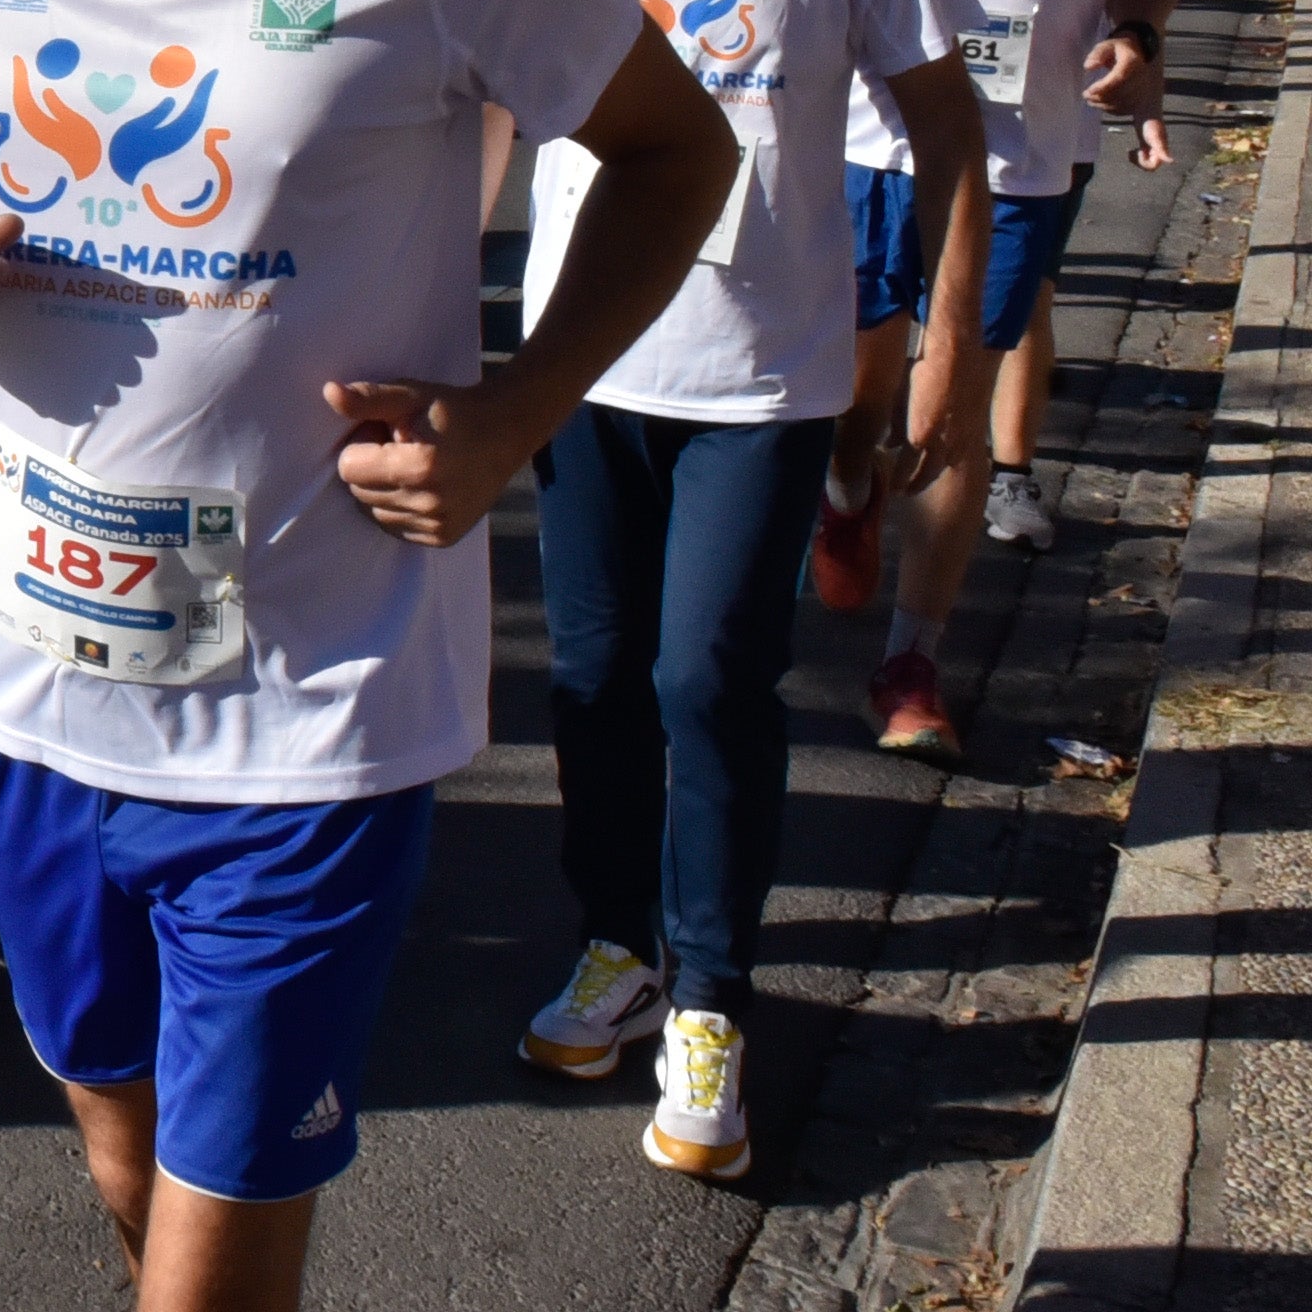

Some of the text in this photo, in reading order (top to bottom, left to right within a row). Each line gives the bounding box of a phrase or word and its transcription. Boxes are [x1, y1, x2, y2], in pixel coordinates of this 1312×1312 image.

[962, 39, 1000, 61] 61
[77, 196, 138, 227] 10ª
[62, 278, 147, 304] ASPACE
[155, 290, 272, 310] GRANADA
[28, 460, 183, 511] CARRERA-MARCHA
[24, 494, 72, 528] ASPACE
[74, 519, 140, 544] Granada
[144, 532, 184, 546] 2025
[48, 490, 138, 525] SOLIDARIA
[27, 525, 158, 596] 187
